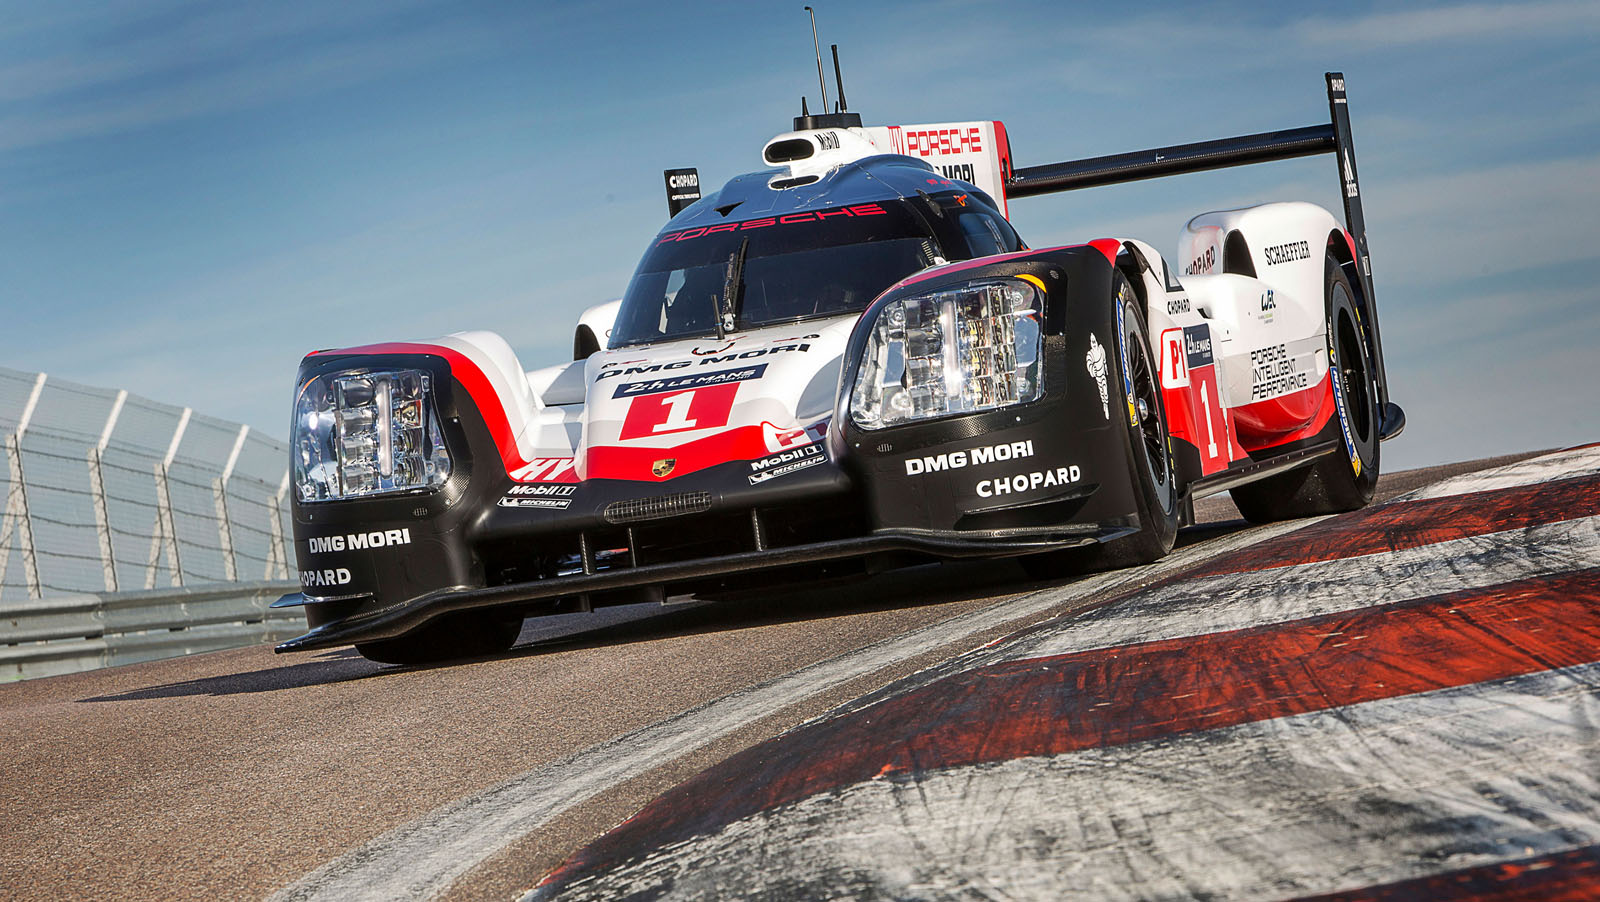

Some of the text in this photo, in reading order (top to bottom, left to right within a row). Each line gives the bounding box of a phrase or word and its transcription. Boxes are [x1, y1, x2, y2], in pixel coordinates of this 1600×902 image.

[906, 127, 982, 156] PORSCHE
[669, 174, 698, 189] CHOPARD
[655, 203, 888, 247] PORSCHE
[1264, 240, 1311, 266] SCHAEFFLER
[1167, 298, 1191, 315] CHOPARD
[595, 343, 811, 383] DMG MORI
[1169, 338, 1187, 380] P1
[1251, 344, 1286, 366] PORSCHE
[667, 375, 695, 387] LE
[695, 369, 756, 383] MANS
[1253, 358, 1296, 384] INTELLIGENT
[1252, 373, 1307, 400] PERFORMANCE
[652, 390, 698, 433] 1
[1200, 380, 1219, 459] 1
[1331, 368, 1353, 445] MICHELIN
[750, 449, 805, 471] Mobil
[773, 456, 825, 476] MICHELIN
[905, 439, 1034, 476] DMG MORI
[507, 485, 560, 495] Mobil
[975, 465, 1082, 498] CHOPARD
[309, 528, 411, 554] DMG MORI
